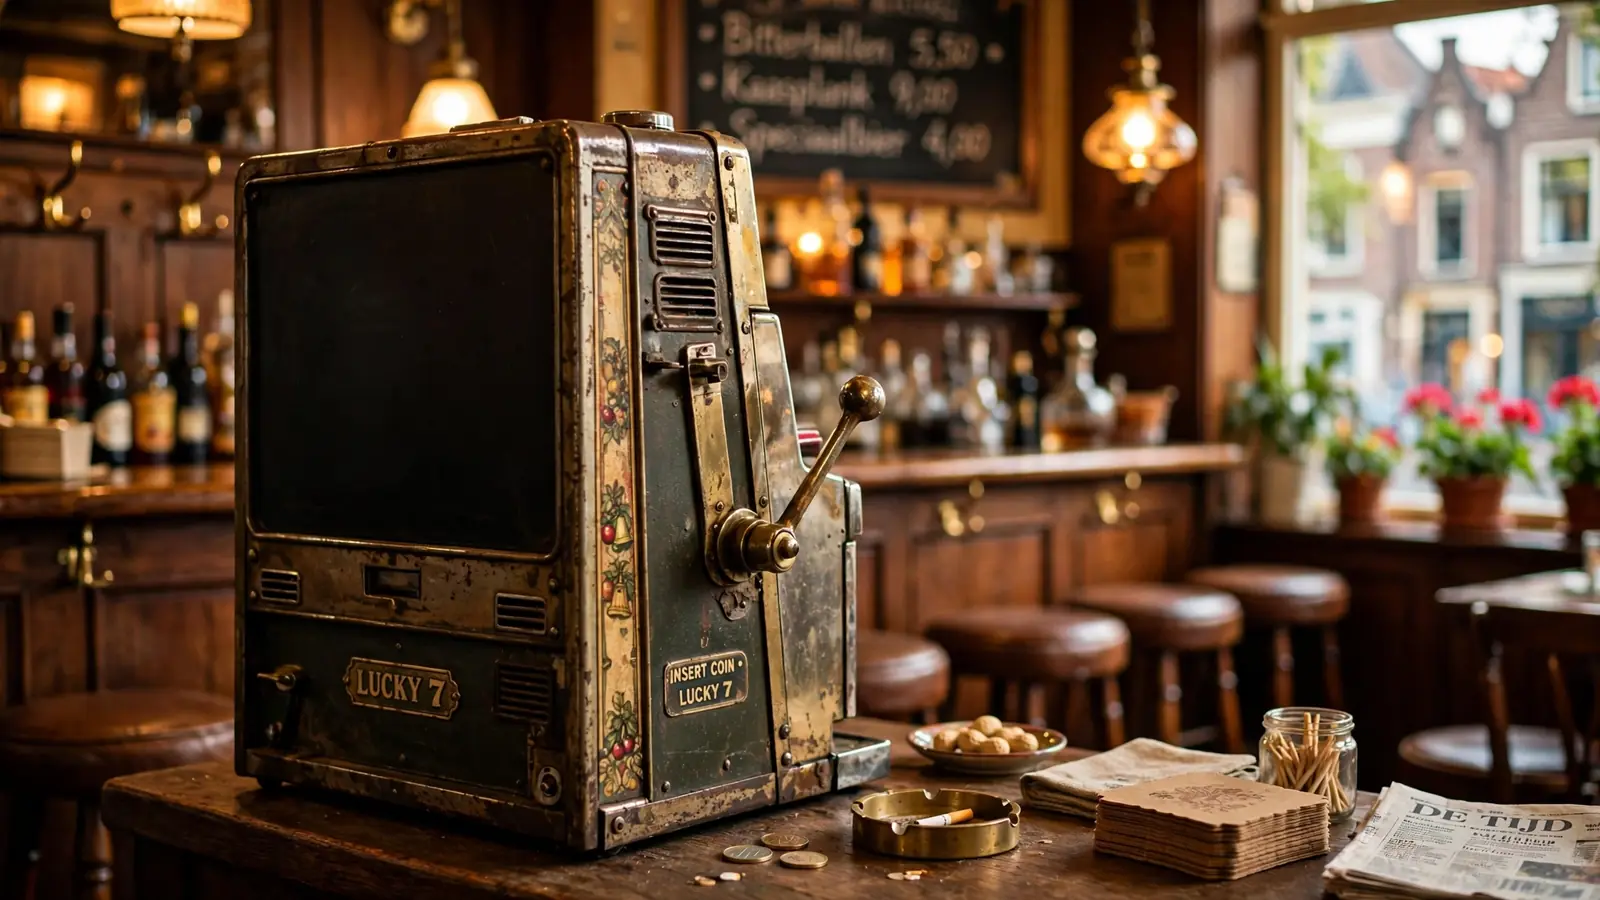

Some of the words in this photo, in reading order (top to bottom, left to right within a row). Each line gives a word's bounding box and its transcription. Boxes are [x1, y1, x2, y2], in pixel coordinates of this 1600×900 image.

[723, 11, 893, 65] Bitterballen
[670, 663, 707, 684] INSERT
[711, 659, 735, 675] COIN
[357, 669, 421, 702] LUCKY
[429, 679, 445, 707] 7
[679, 683, 720, 706] LUCKY
[723, 681, 732, 697] 7
[1410, 803, 1467, 822] DE
[1480, 815, 1572, 833] TIJD
